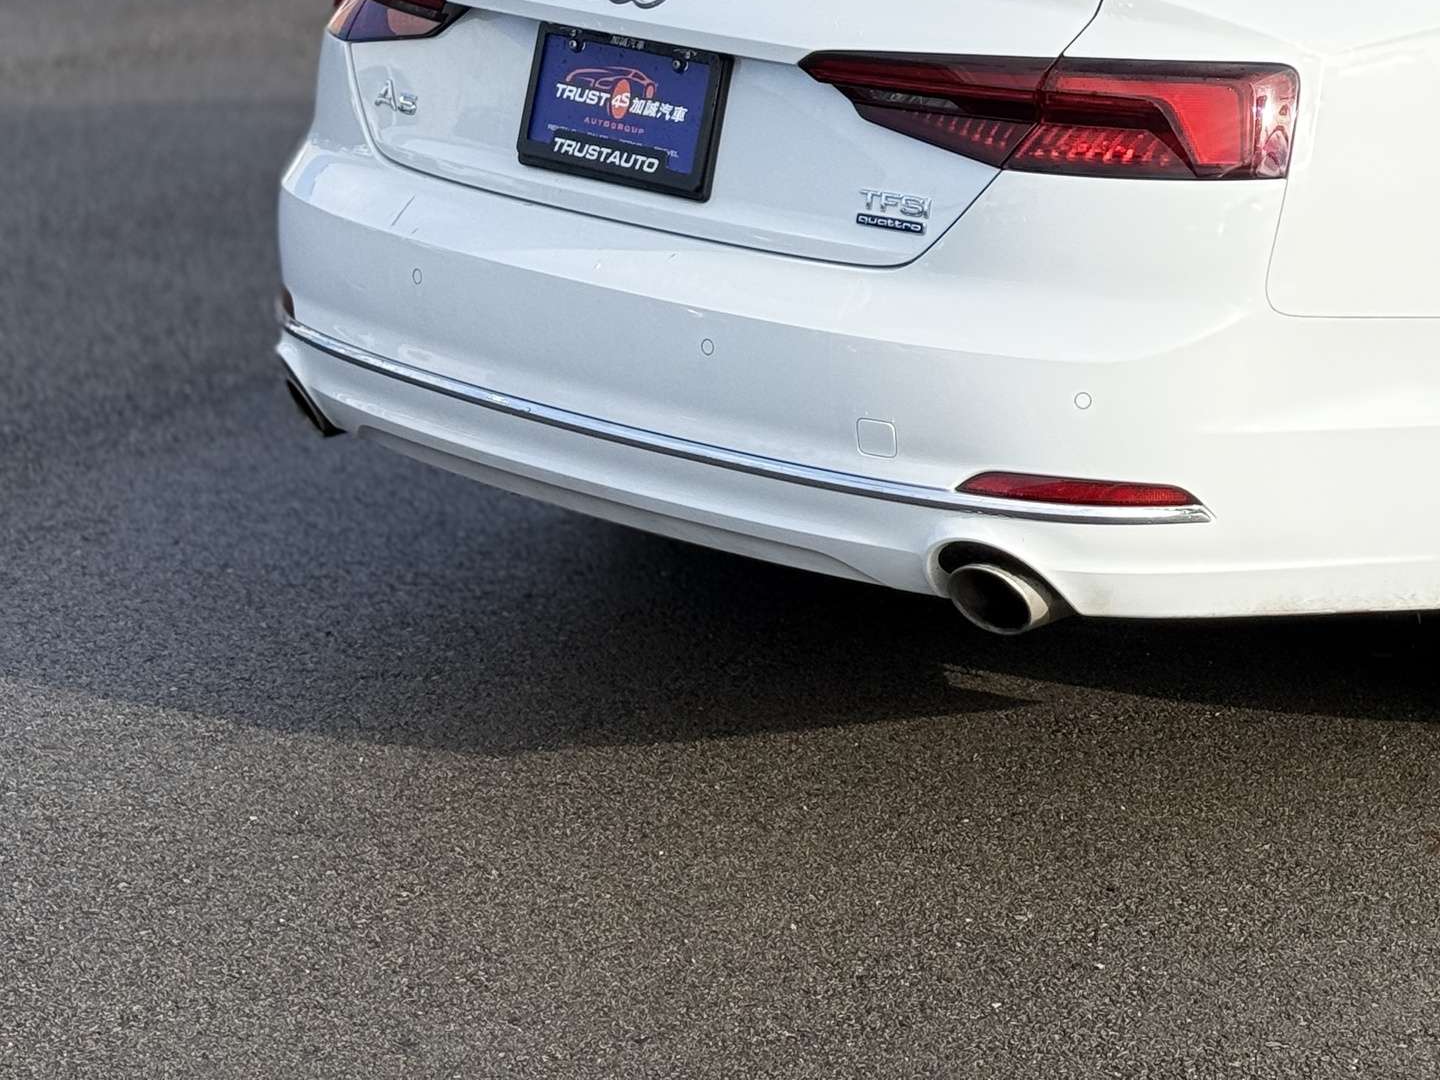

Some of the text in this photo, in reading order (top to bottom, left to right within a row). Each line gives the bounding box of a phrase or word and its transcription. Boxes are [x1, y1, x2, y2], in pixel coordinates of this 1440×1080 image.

[374, 79, 418, 116] A5
[556, 83, 610, 107] TRUST
[611, 92, 631, 108] 4S
[584, 117, 645, 134] AUTOGROUP
[553, 137, 659, 173] TRUSTAUTO
[859, 187, 931, 219] TFSI
[858, 215, 921, 231] quattro
